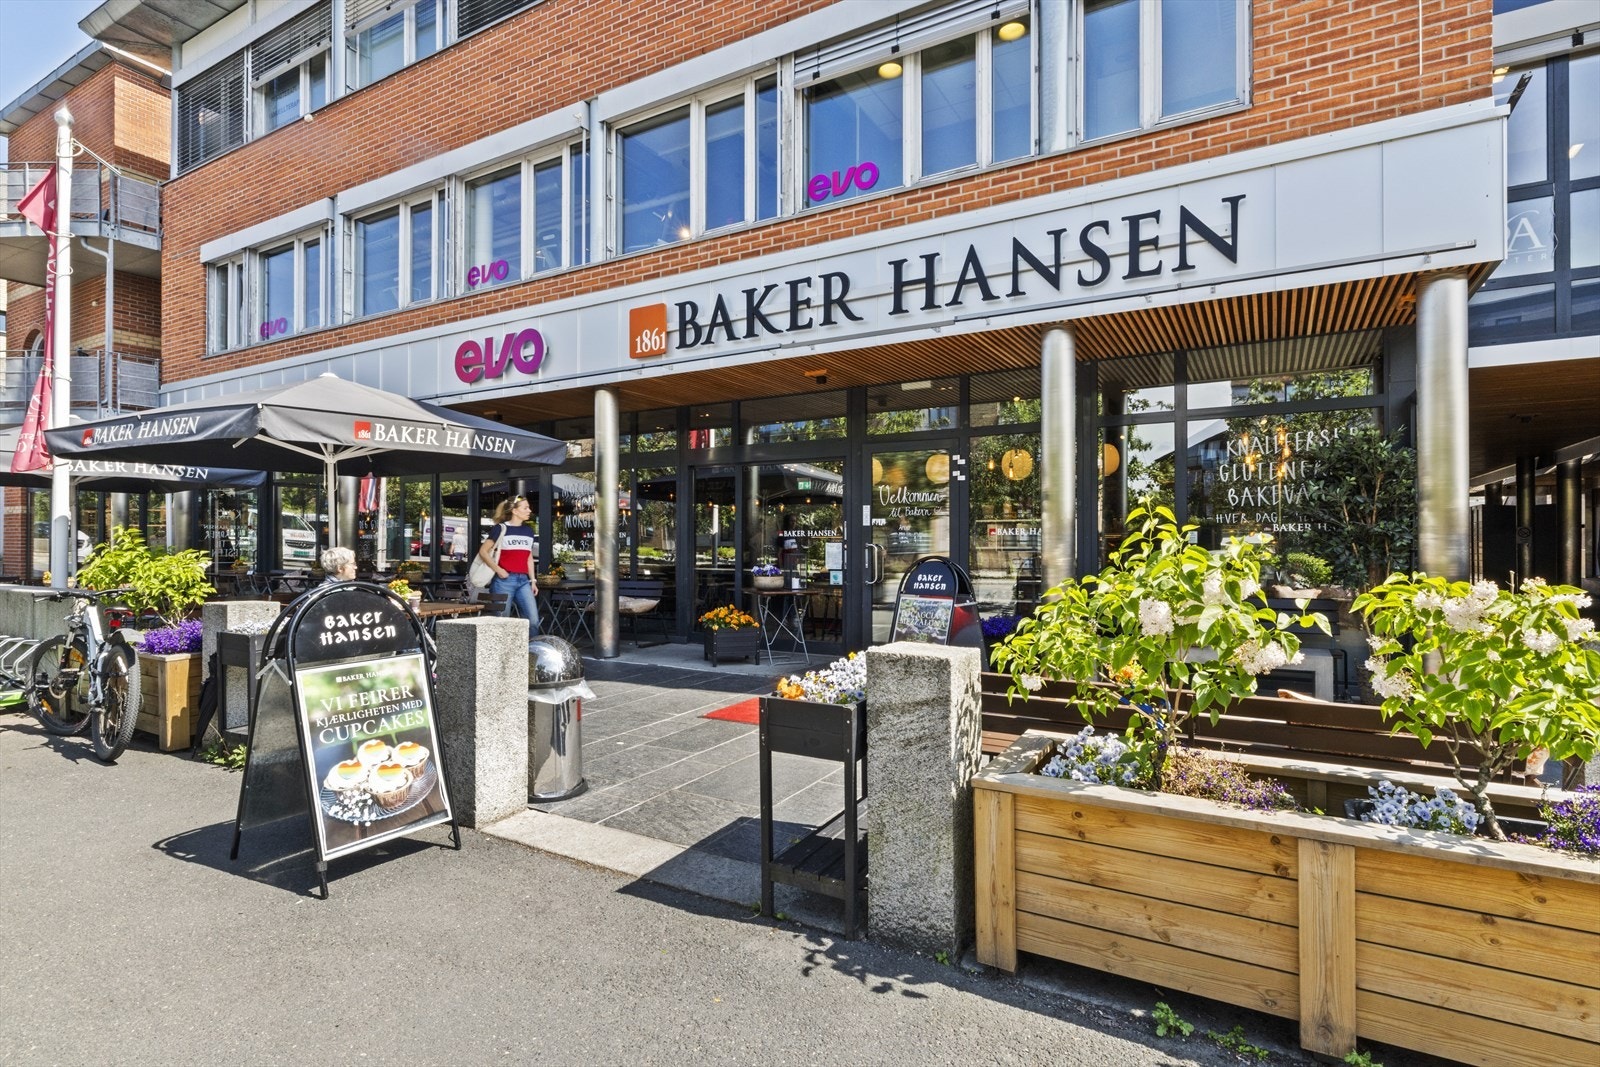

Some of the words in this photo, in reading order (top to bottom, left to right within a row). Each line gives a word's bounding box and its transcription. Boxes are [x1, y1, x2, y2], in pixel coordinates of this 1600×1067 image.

[807, 161, 880, 203] evo
[467, 258, 509, 288] evo
[635, 330, 667, 353] 1861
[675, 270, 863, 350] BAKER
[888, 194, 1247, 315] HANSEN
[260, 316, 288, 340] evo
[455, 327, 546, 384] evo
[92, 423, 135, 446] BAKER
[137, 416, 200, 439] HANSEN
[374, 423, 440, 446] BAKER
[445, 430, 517, 454] HANSEN
[134, 463, 209, 480] HANSEN
[807, 529, 837, 537] HANSEN
[997, 528, 1027, 536] BAKER
[343, 673, 365, 682] BAKER
[316, 703, 400, 728] KJÆRLIGHETEN
[402, 699, 423, 710] MED
[319, 695, 342, 713] VI
[348, 685, 414, 709] FEIRER
[319, 710, 425, 744] CUPCAKES
